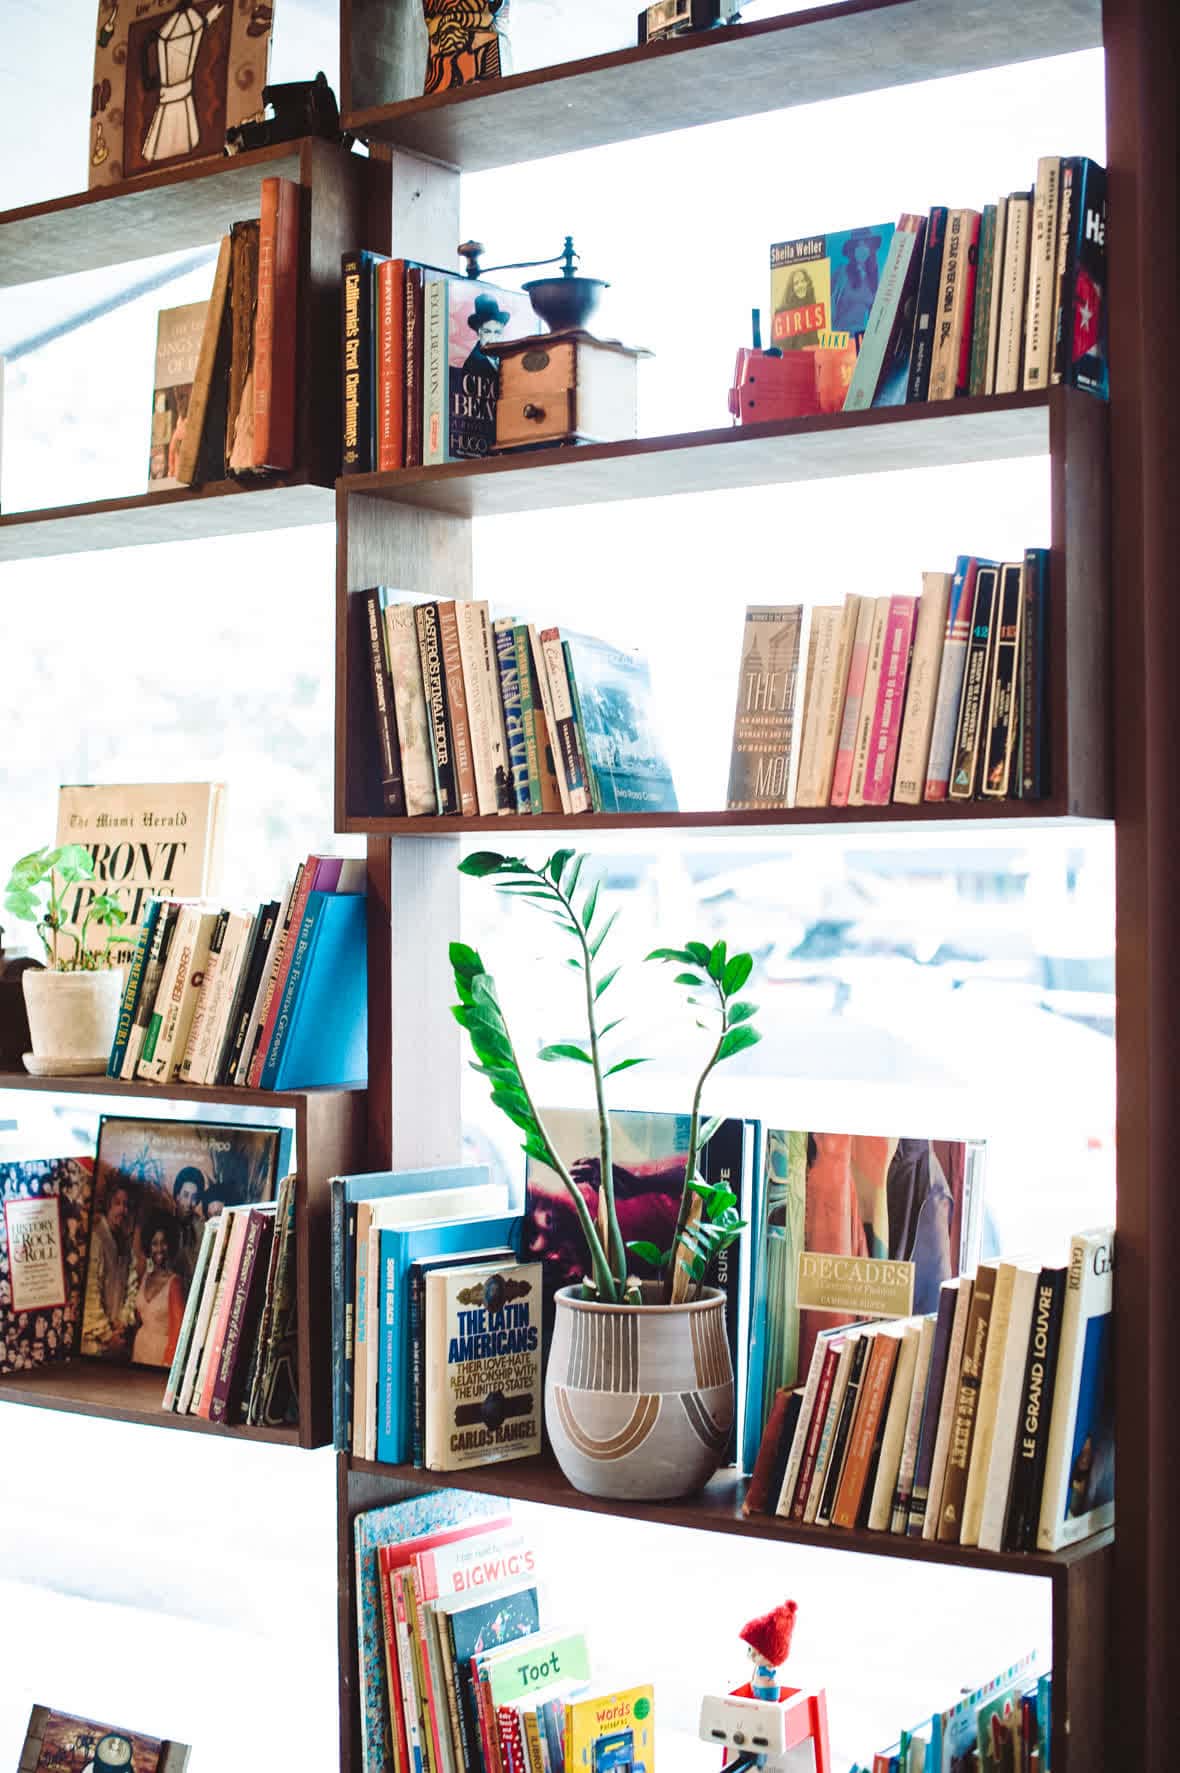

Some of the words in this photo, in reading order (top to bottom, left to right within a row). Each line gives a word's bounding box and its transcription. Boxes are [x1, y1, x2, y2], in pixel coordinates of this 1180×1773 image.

[952, 217, 961, 235] RED
[796, 240, 822, 257] Weller
[948, 237, 959, 258] STAR
[947, 260, 957, 284] OVER
[345, 275, 360, 337] California's
[384, 278, 392, 326] SAVING
[943, 285, 955, 313] CHINA
[774, 306, 824, 337] GIRLS
[345, 339, 359, 370] Great
[384, 329, 392, 363] ITALY
[345, 374, 358, 447] Chardonnays
[424, 606, 440, 675] CASTRO'S
[440, 612, 460, 673] HAVANA
[375, 673, 386, 712] JOURNEY
[430, 675, 444, 723] FINAL
[746, 672, 780, 711] THE
[436, 723, 448, 767] HOUR
[144, 812, 187, 826] Herald
[302, 917, 315, 939] THE
[294, 940, 308, 966] BEST
[124, 947, 147, 1011] REMEMBER
[171, 946, 191, 1003] CENSORED
[283, 969, 301, 1014] FLORIDA
[116, 1013, 132, 1046] CUBA
[267, 1015, 290, 1069] GETAWAYS
[23, 1233, 56, 1248] ROCK
[25, 1247, 57, 1262] ROLL
[386, 1257, 395, 1290] SOUTH
[802, 1257, 909, 1286] DECADES
[386, 1292, 395, 1325] BEACH
[457, 1309, 484, 1337] THE
[486, 1303, 530, 1331] LATIN
[1033, 1286, 1054, 1358] LOUVRE
[448, 1326, 538, 1364] AMERICANS
[450, 1368, 513, 1388] RELATIONSHIP
[514, 1366, 538, 1378] WITH
[456, 1360, 484, 1376] THEIR
[484, 1353, 531, 1371] LOVE-HATE
[454, 1386, 472, 1400] THE
[472, 1382, 504, 1398] UNITED
[504, 1378, 534, 1392] STATES
[1024, 1363, 1044, 1433] GRAND
[450, 1429, 494, 1452] CARLOS
[495, 1420, 537, 1442] RANGEL
[1022, 1438, 1035, 1458] LE
[452, 1550, 535, 1592] BIGWIG'S
[518, 1651, 561, 1686] Toot
[596, 1702, 631, 1723] words
